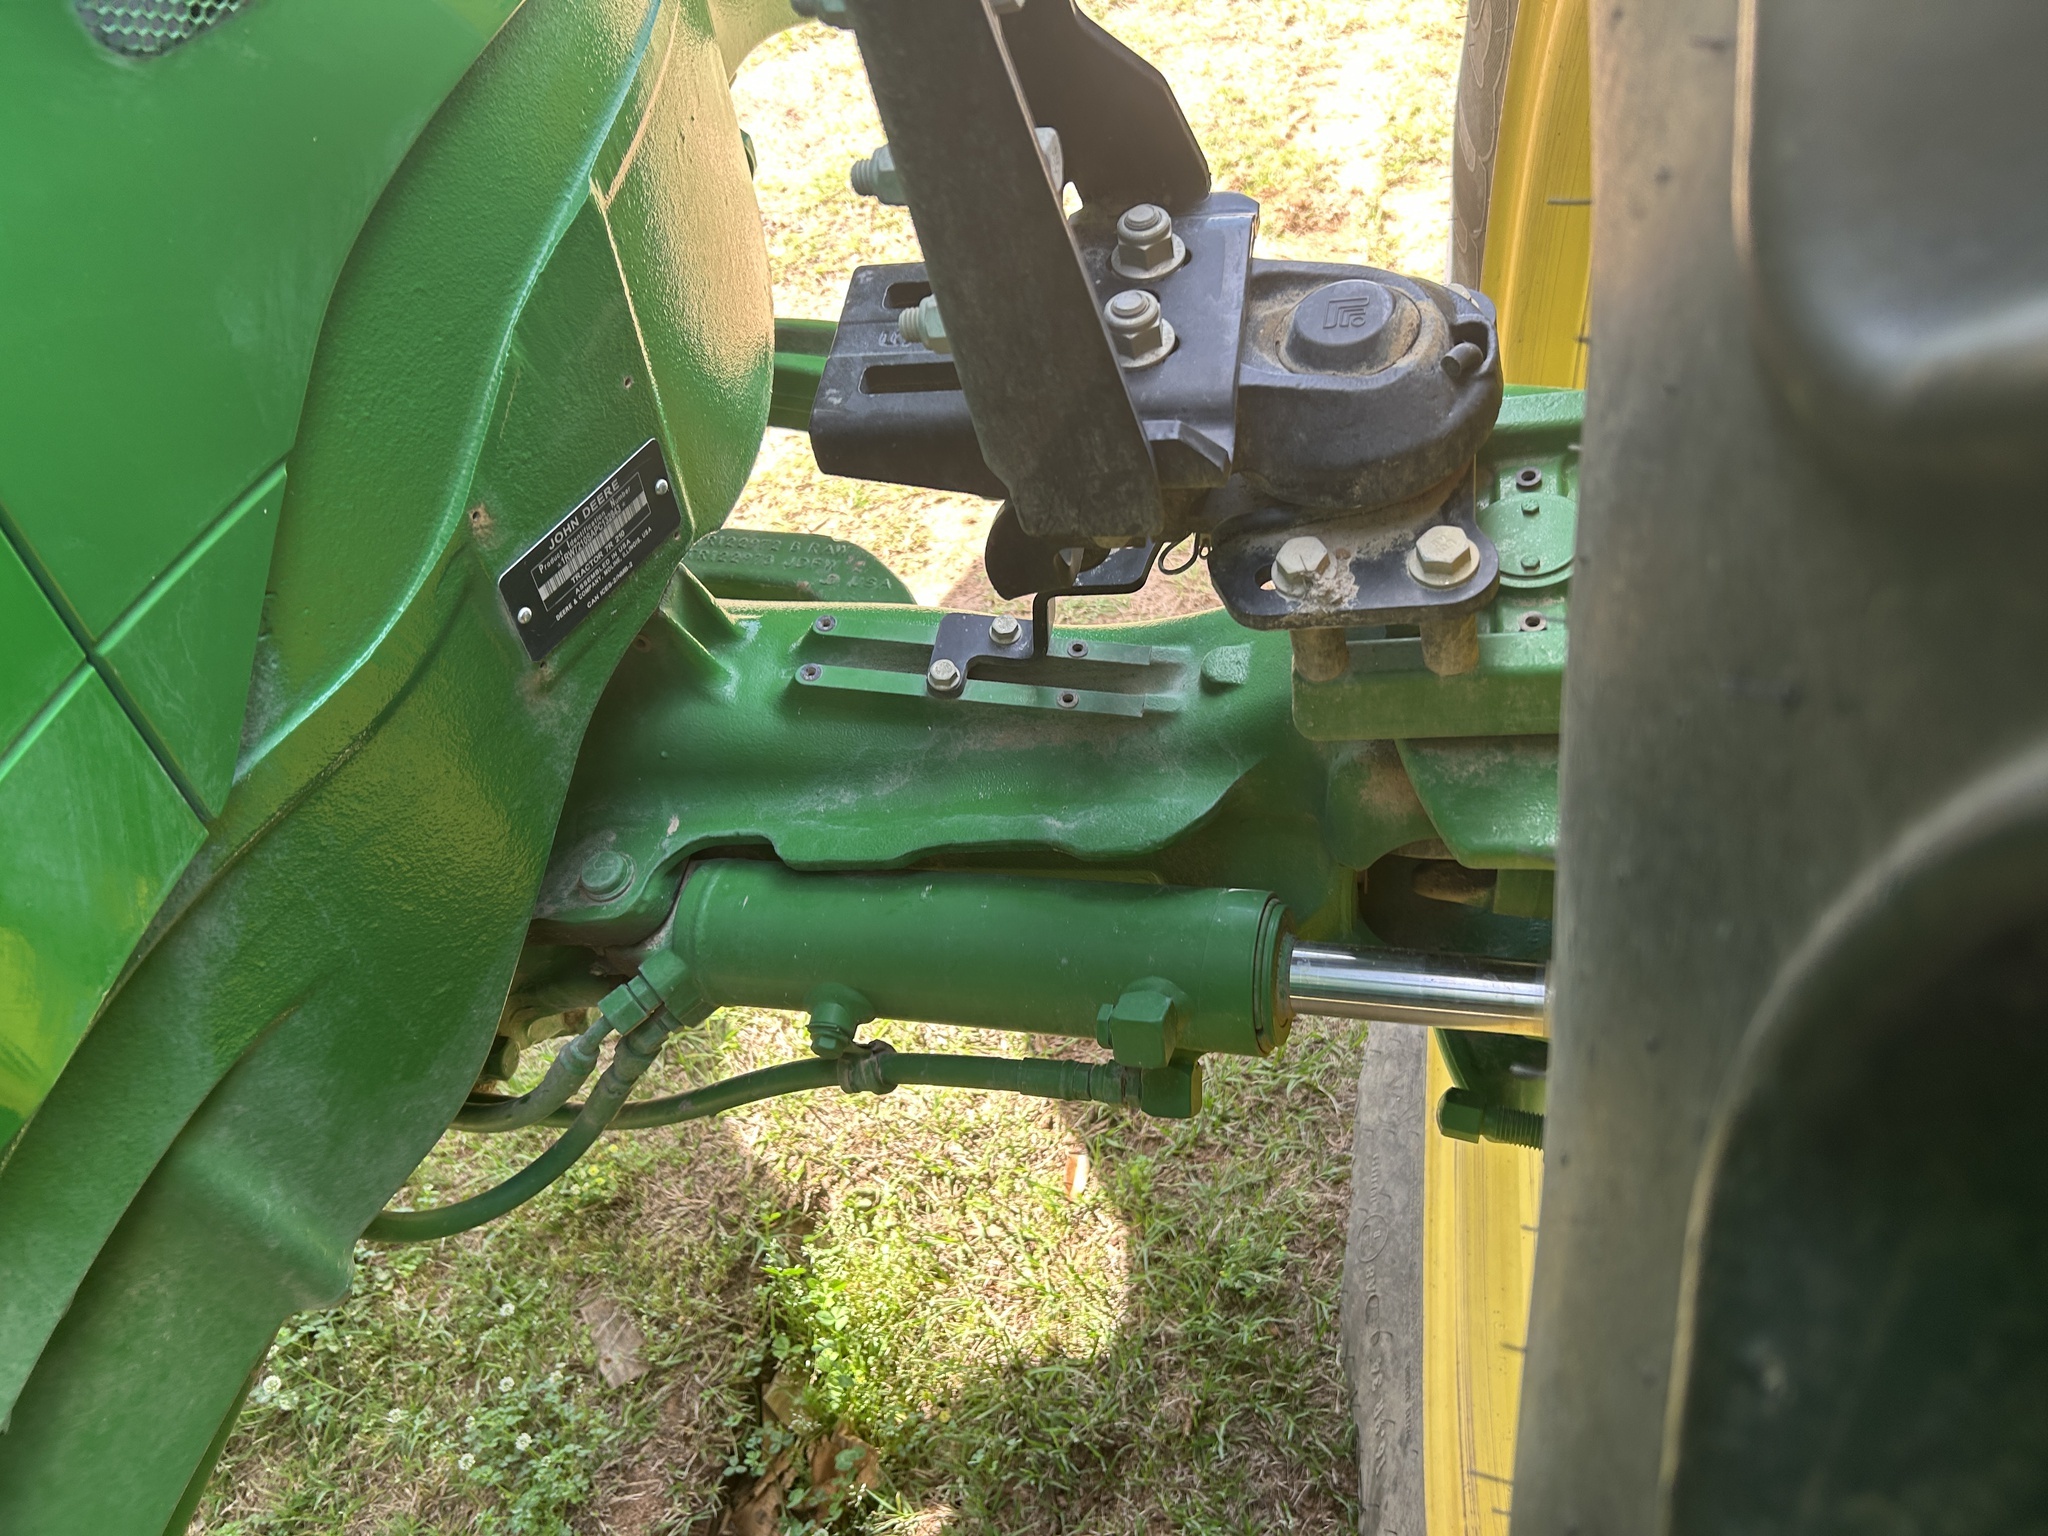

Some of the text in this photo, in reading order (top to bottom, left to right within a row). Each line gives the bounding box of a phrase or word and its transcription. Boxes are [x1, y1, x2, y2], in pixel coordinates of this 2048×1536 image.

[538, 486, 631, 574] Product Identification Number
[549, 478, 620, 551] JOHN DEERE
[555, 603, 573, 621] DEERE
[578, 577, 604, 600] COMPANY,
[603, 556, 623, 576] MOLINE,
[622, 537, 643, 558] ILLINOIS,
[641, 526, 652, 539] USA
[571, 530, 625, 584] TRACTOR 7R 210
[575, 539, 631, 594] ASSEMBLED IN USA
[586, 595, 600, 608] CAN
